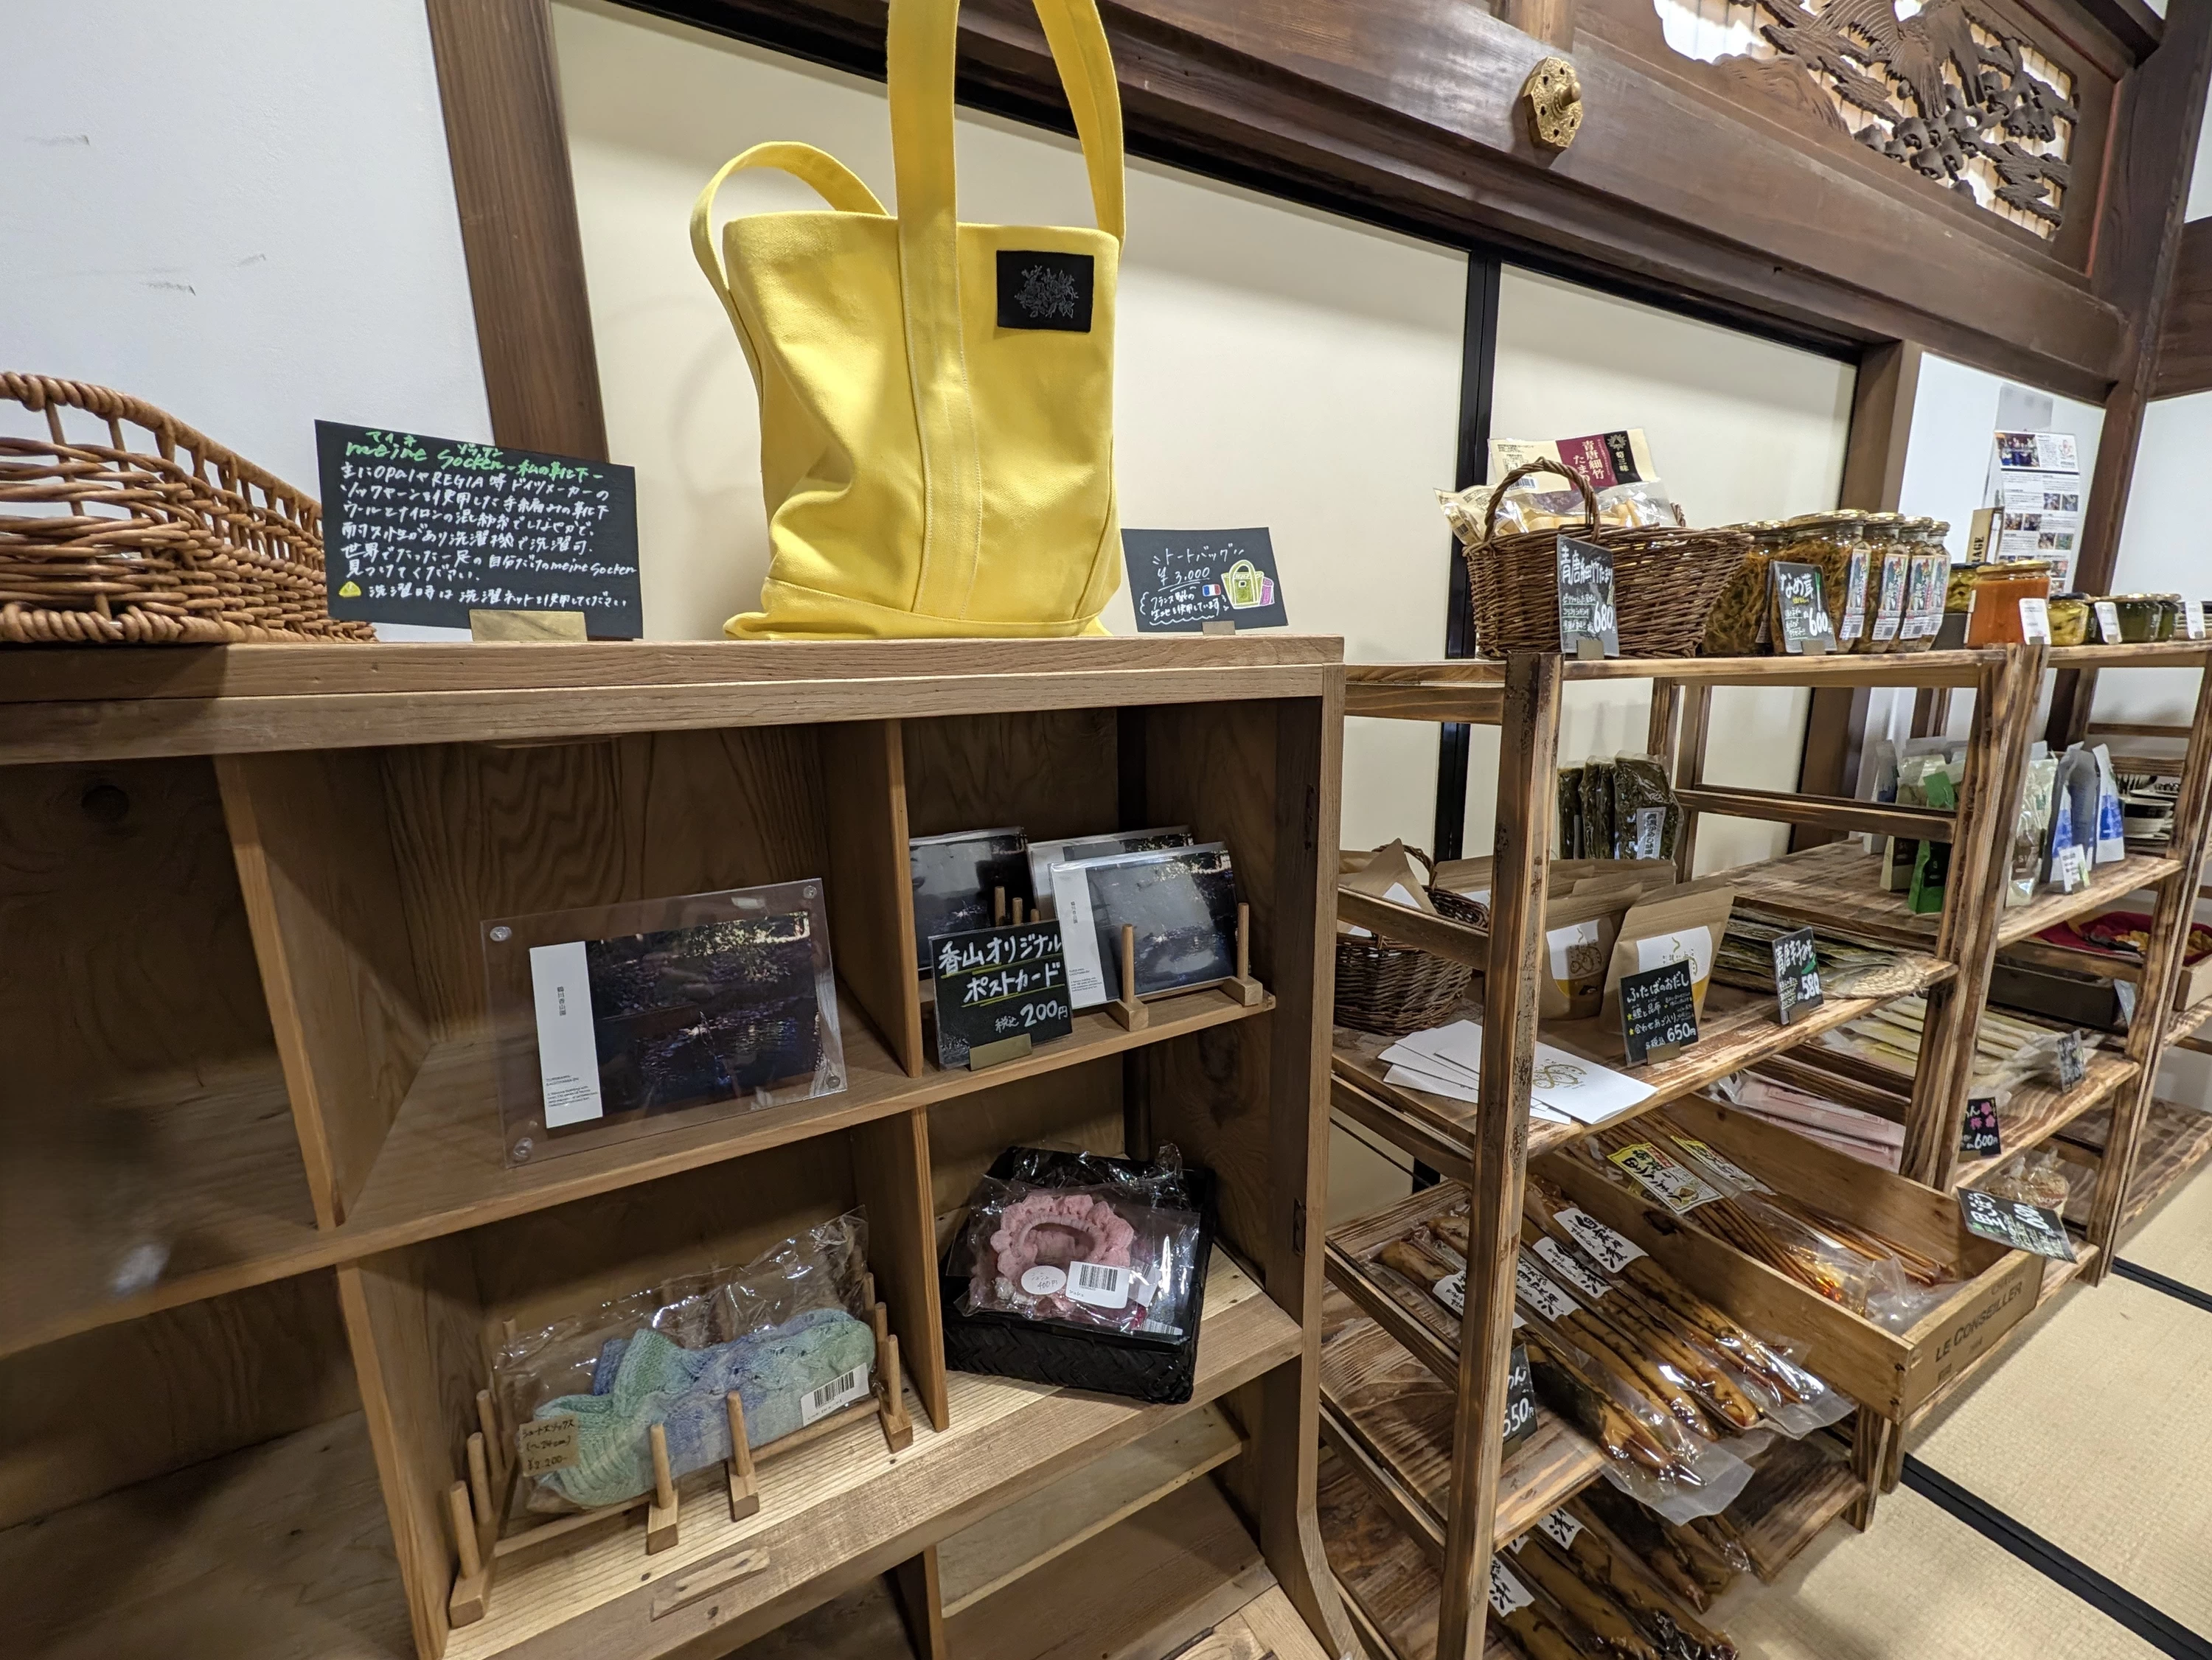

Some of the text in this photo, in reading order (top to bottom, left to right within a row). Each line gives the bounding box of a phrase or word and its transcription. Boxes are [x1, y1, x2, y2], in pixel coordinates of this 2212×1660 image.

[345, 442, 428, 462] meine
[437, 449, 506, 470] Socken
[590, 562, 637, 576] Socken
[938, 933, 1062, 975] 香山オリジナル
[963, 961, 1061, 1003] ポストカード
[1627, 971, 1689, 1002] ふたばのおだし
[1020, 1000, 1068, 1028] 200円
